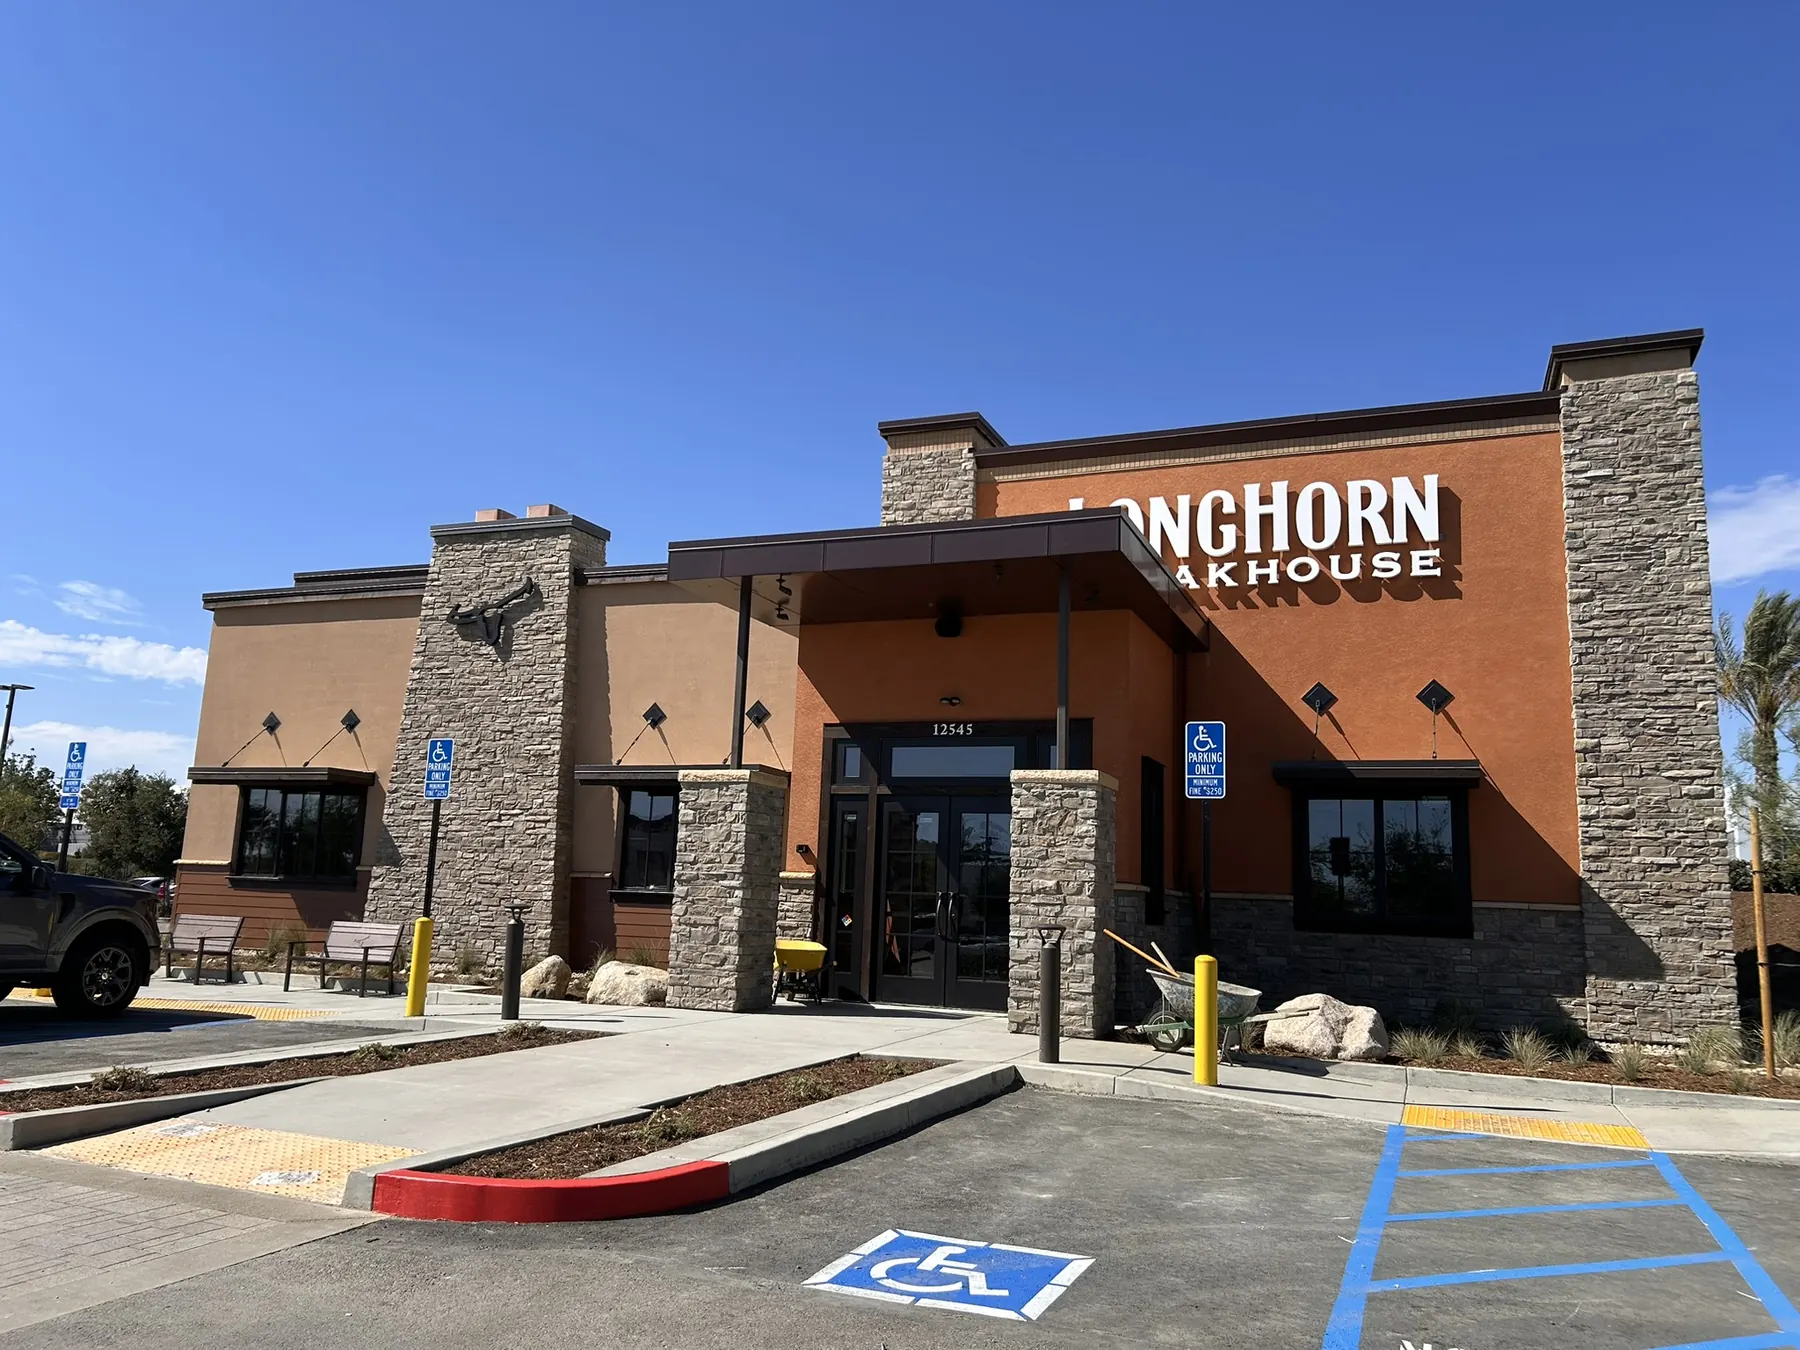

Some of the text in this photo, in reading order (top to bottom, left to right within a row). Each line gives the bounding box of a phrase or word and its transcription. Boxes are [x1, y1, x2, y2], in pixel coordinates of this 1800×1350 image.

[1068, 473, 1440, 558] NGHORN
[1175, 548, 1442, 590] AKHOUSE
[933, 723, 973, 736] 12545
[1188, 751, 1223, 763] PARKING
[428, 762, 451, 771] PARKING
[1195, 764, 1216, 775] ONLY
[431, 772, 446, 781] ONLY
[1192, 778, 1218, 787] MINIMUM
[1188, 786, 1202, 796] FINE
